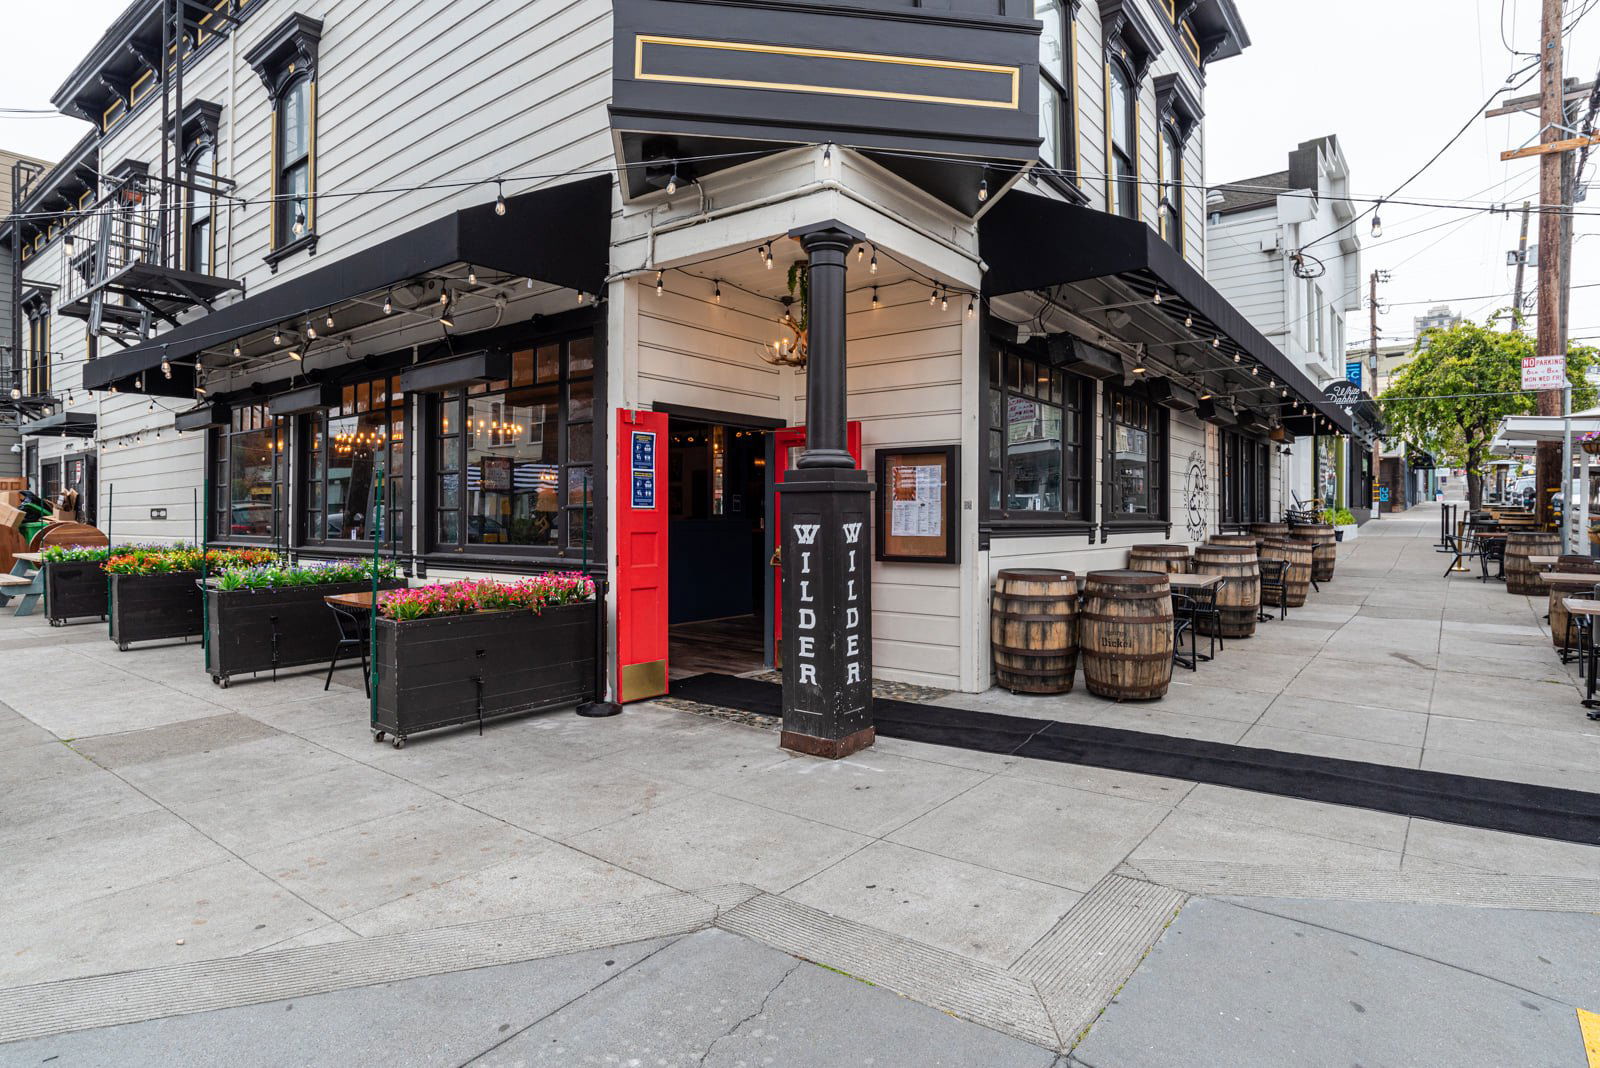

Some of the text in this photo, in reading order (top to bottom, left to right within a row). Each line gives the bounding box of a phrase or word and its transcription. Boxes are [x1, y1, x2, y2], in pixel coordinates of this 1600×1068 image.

[1333, 385, 1360, 396] White
[1523, 359, 1535, 367] NO
[793, 524, 821, 686] WILDER
[842, 522, 863, 685] WILDER
